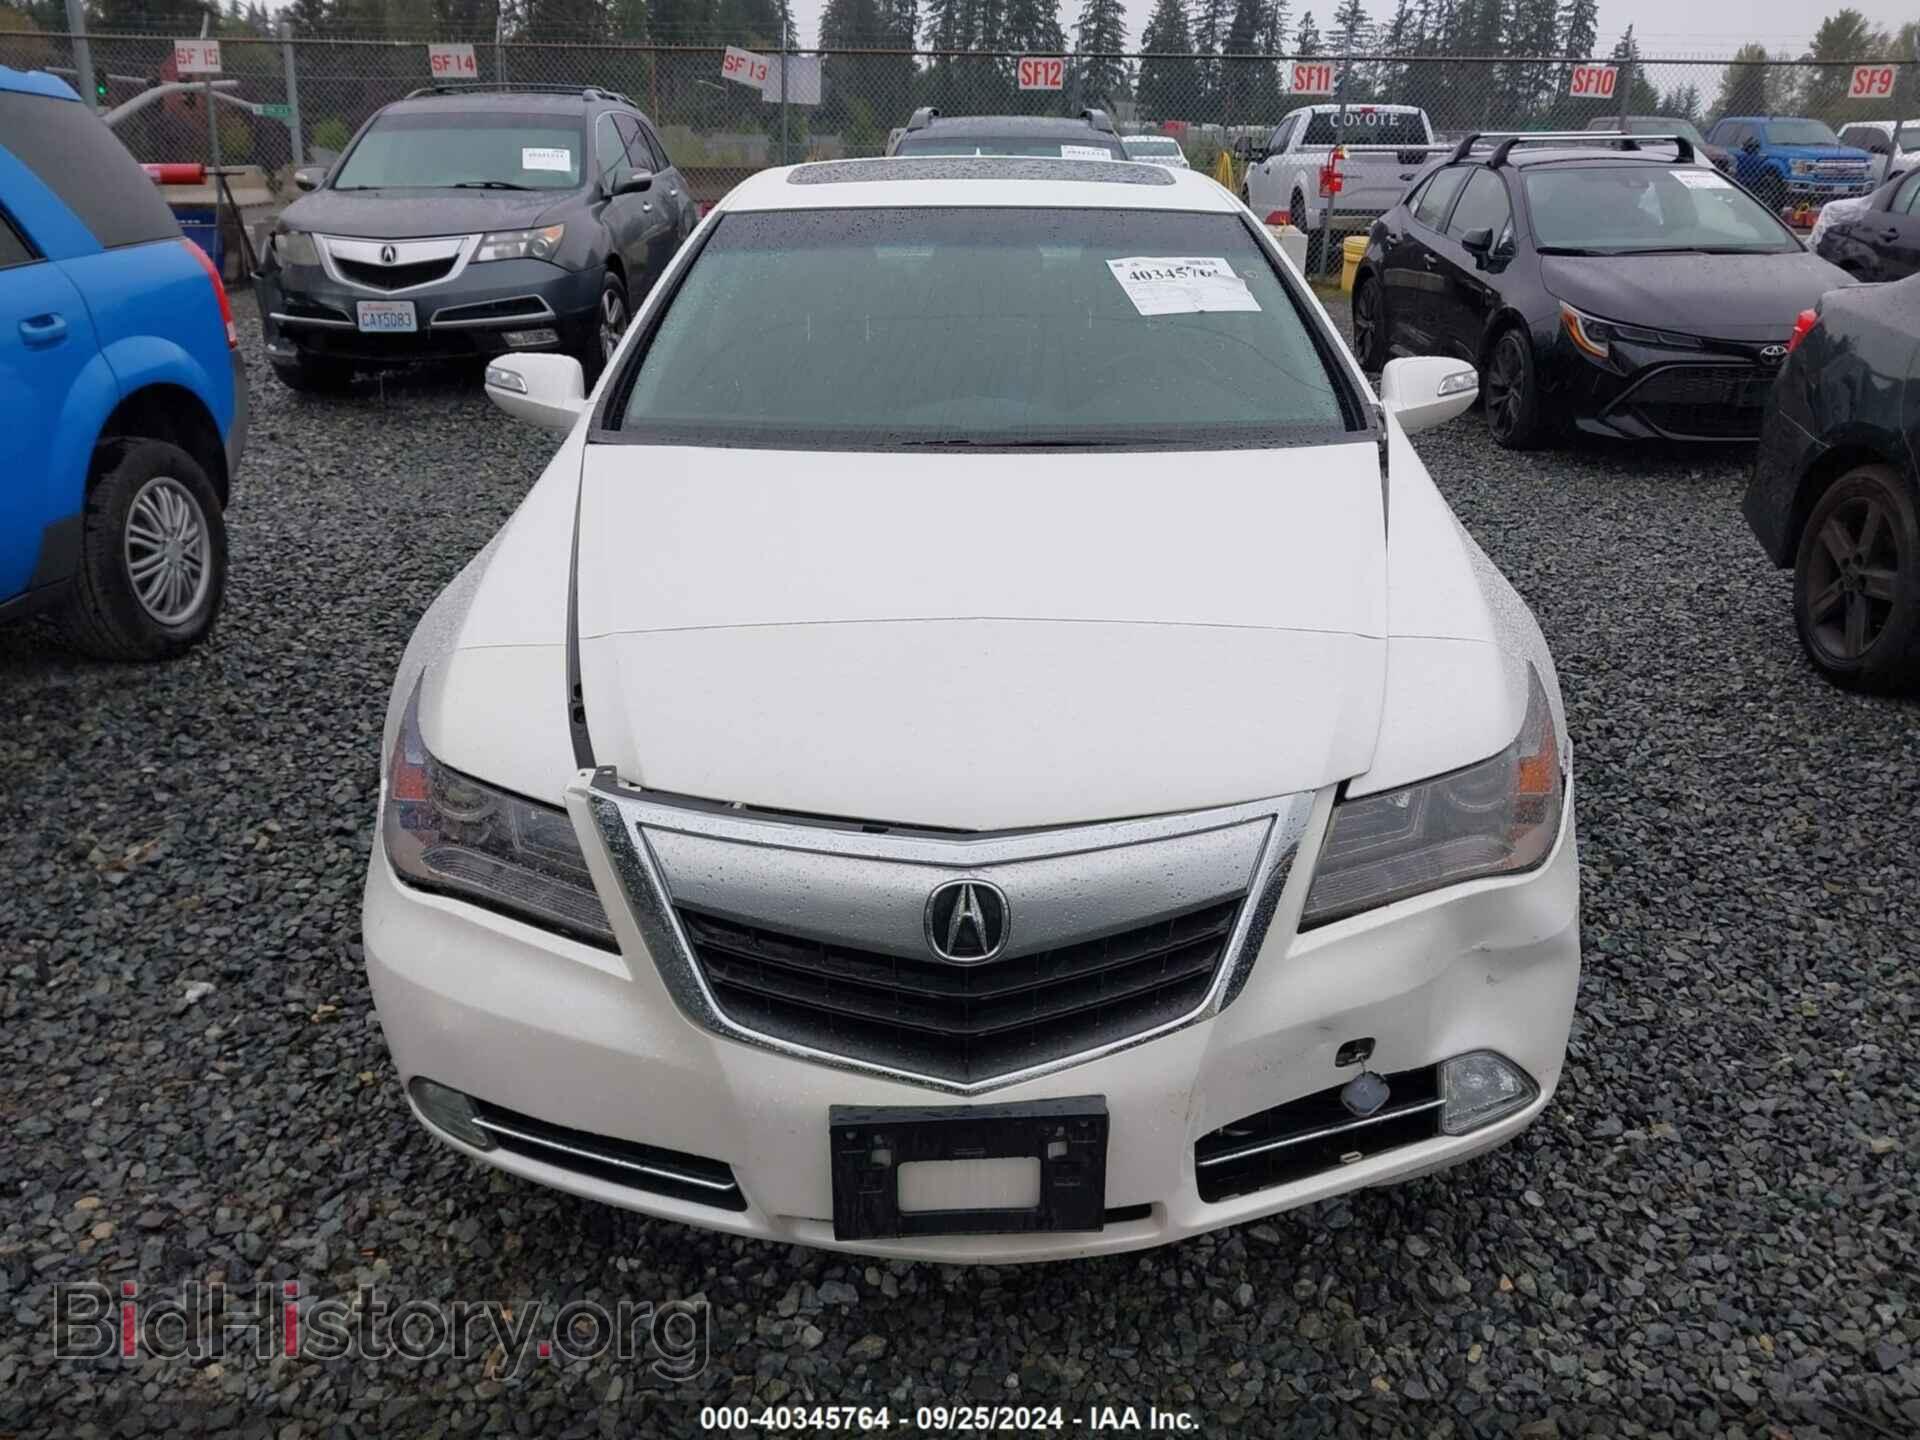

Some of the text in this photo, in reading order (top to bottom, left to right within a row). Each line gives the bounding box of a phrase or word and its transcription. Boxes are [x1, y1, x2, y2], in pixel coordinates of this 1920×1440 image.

[1021, 61, 1062, 86] SF12
[1294, 65, 1331, 91] SF11
[1572, 67, 1614, 96] SF10
[1853, 68, 1893, 94] SF9
[1329, 112, 1400, 128] COYOTE
